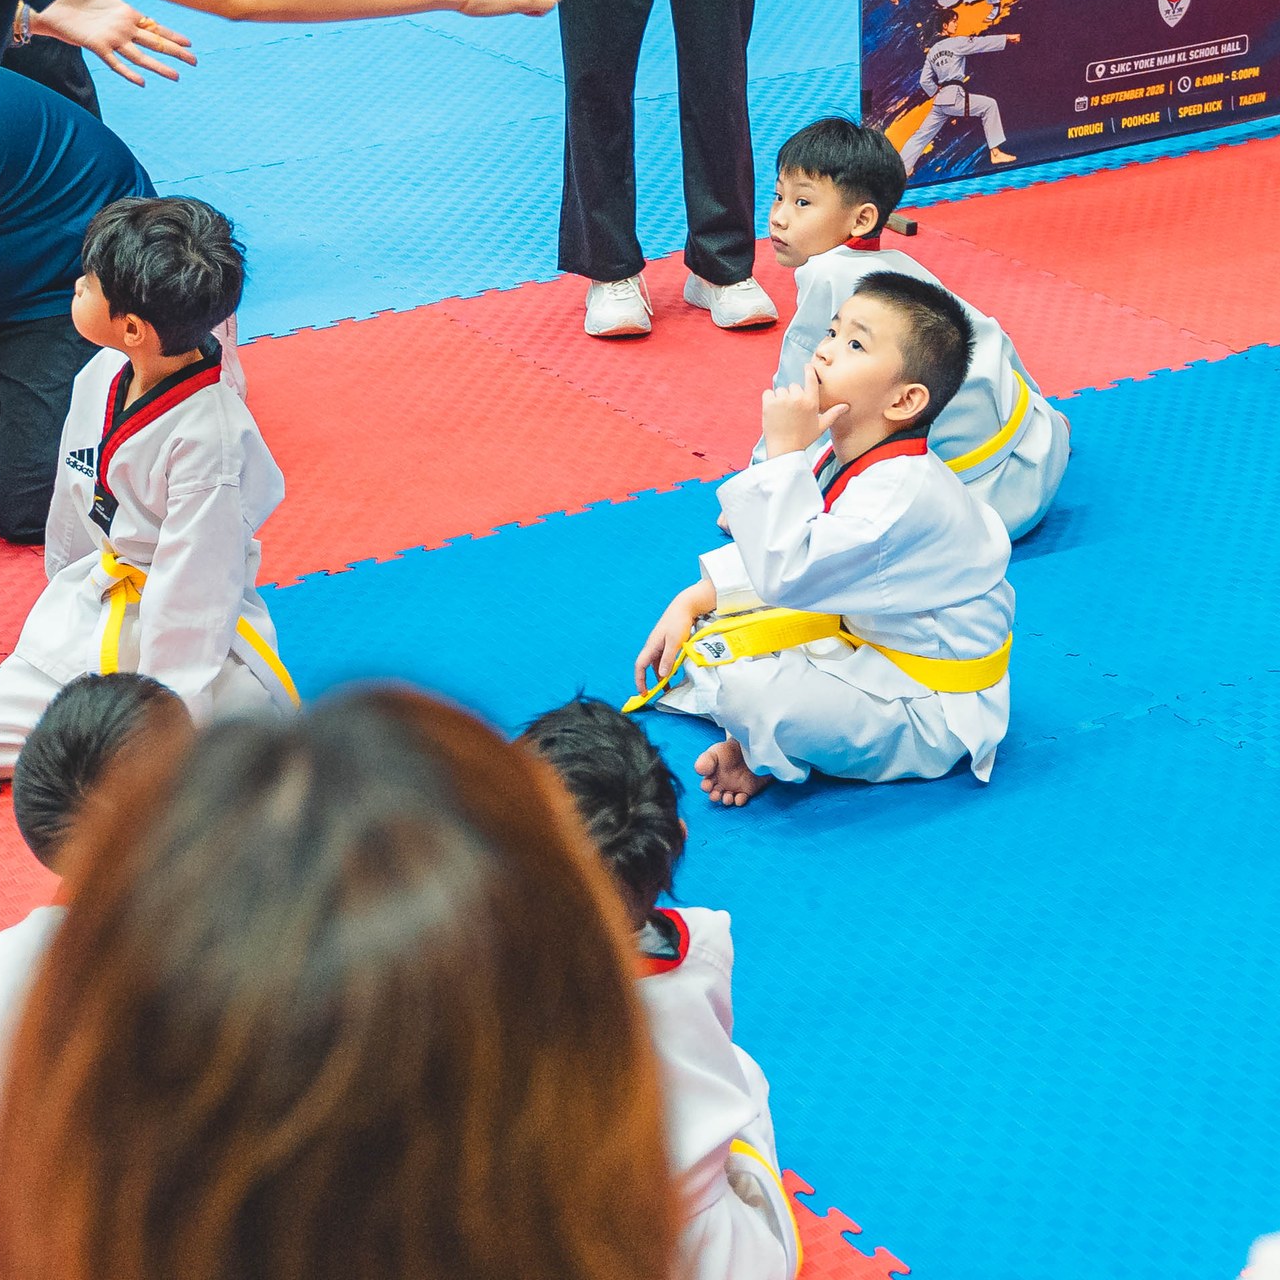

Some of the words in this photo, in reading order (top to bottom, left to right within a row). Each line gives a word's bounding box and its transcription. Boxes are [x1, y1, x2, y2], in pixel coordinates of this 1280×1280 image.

[1110, 62, 1132, 75] SJKC
[1133, 57, 1155, 70] YOKE
[1156, 54, 1176, 66] NAM
[1177, 52, 1187, 63] KL
[1189, 45, 1220, 60] SCHOOL
[1221, 41, 1241, 54] HALL
[1195, 72, 1224, 88] 8:00AM
[1231, 67, 1260, 81] 5:00PM
[1090, 95, 1100, 107] 19
[1100, 87, 1145, 106] SEPTEMBER
[1145, 83, 1165, 97] 2026
[1239, 91, 1266, 107] TAEKIN
[1178, 104, 1202, 118] SPEED
[1204, 99, 1223, 113] KICK
[1121, 111, 1160, 129] POOMSAE
[1068, 122, 1103, 139] KYORUGI
[66, 457, 95, 478] adidas
